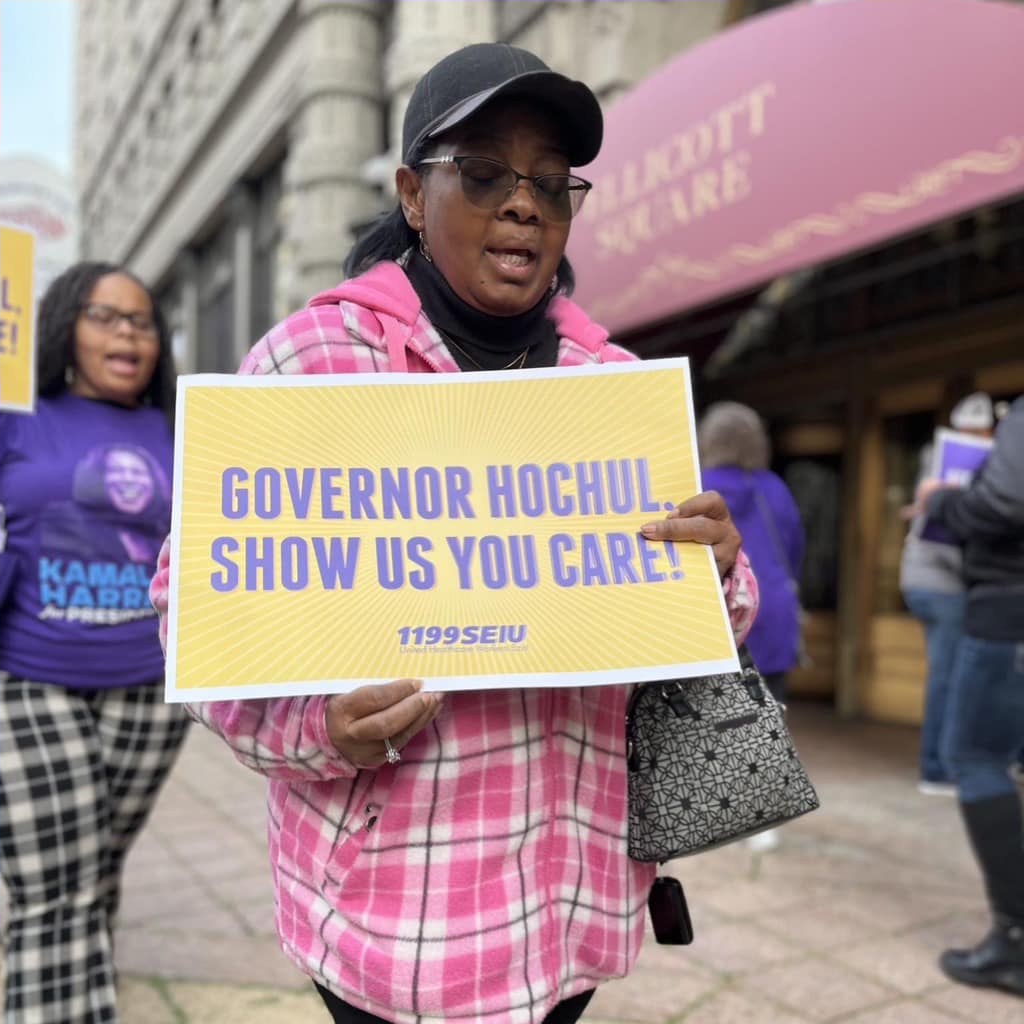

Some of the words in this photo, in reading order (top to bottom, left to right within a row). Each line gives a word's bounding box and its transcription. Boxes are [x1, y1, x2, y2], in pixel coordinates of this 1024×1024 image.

[221, 465, 476, 521] GOVERNOR
[210, 536, 361, 594] SHOW
[376, 535, 436, 591] US
[445, 534, 540, 591] YOU
[547, 532, 685, 588] CARE!
[398, 625, 527, 645] 1199SEIU
